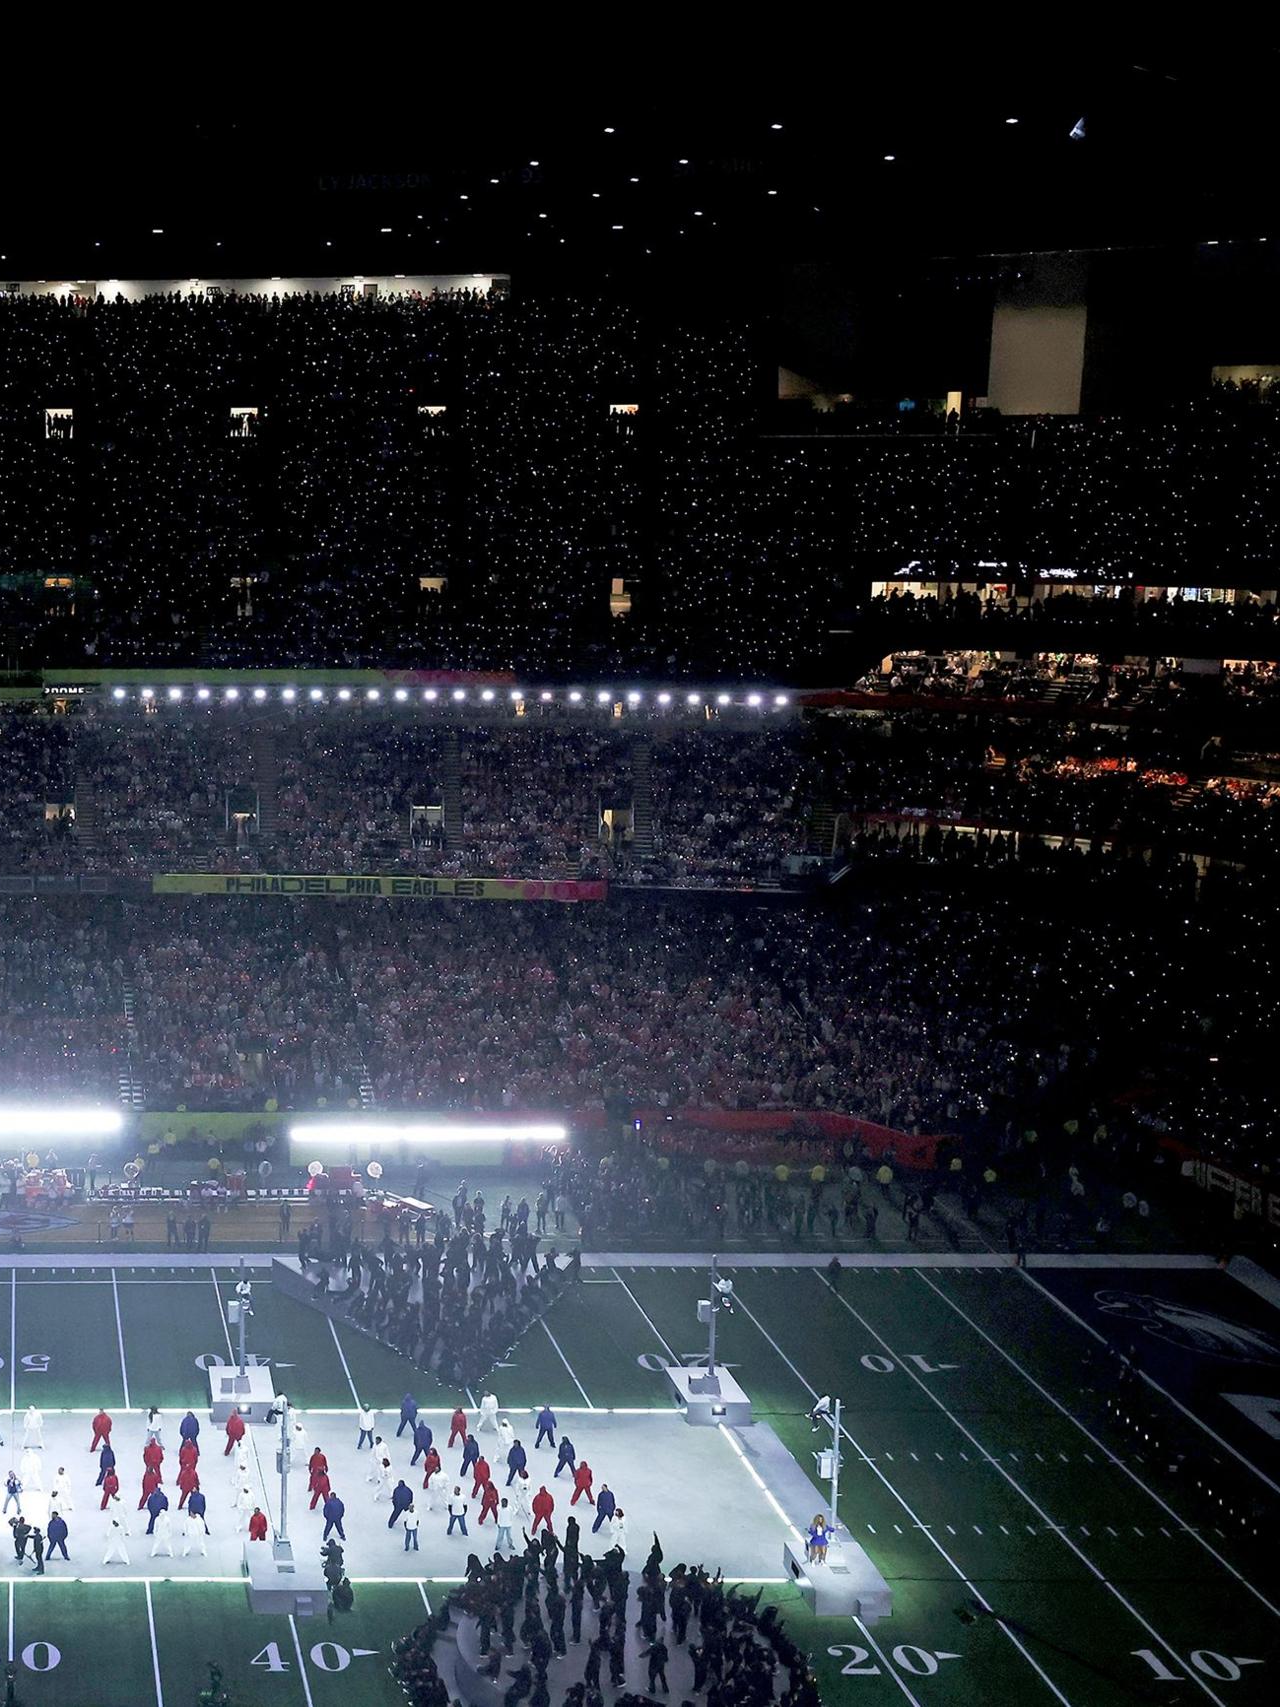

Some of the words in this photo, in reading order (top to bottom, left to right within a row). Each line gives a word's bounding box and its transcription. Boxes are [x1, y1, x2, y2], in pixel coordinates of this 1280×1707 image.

[226, 877, 382, 894] PHILADELPHIA
[392, 879, 485, 897] EAGLES
[860, 1353, 944, 1373] 10
[250, 1641, 351, 1672] 40
[826, 1644, 939, 1675] 20
[1129, 1648, 1242, 1681] 10
